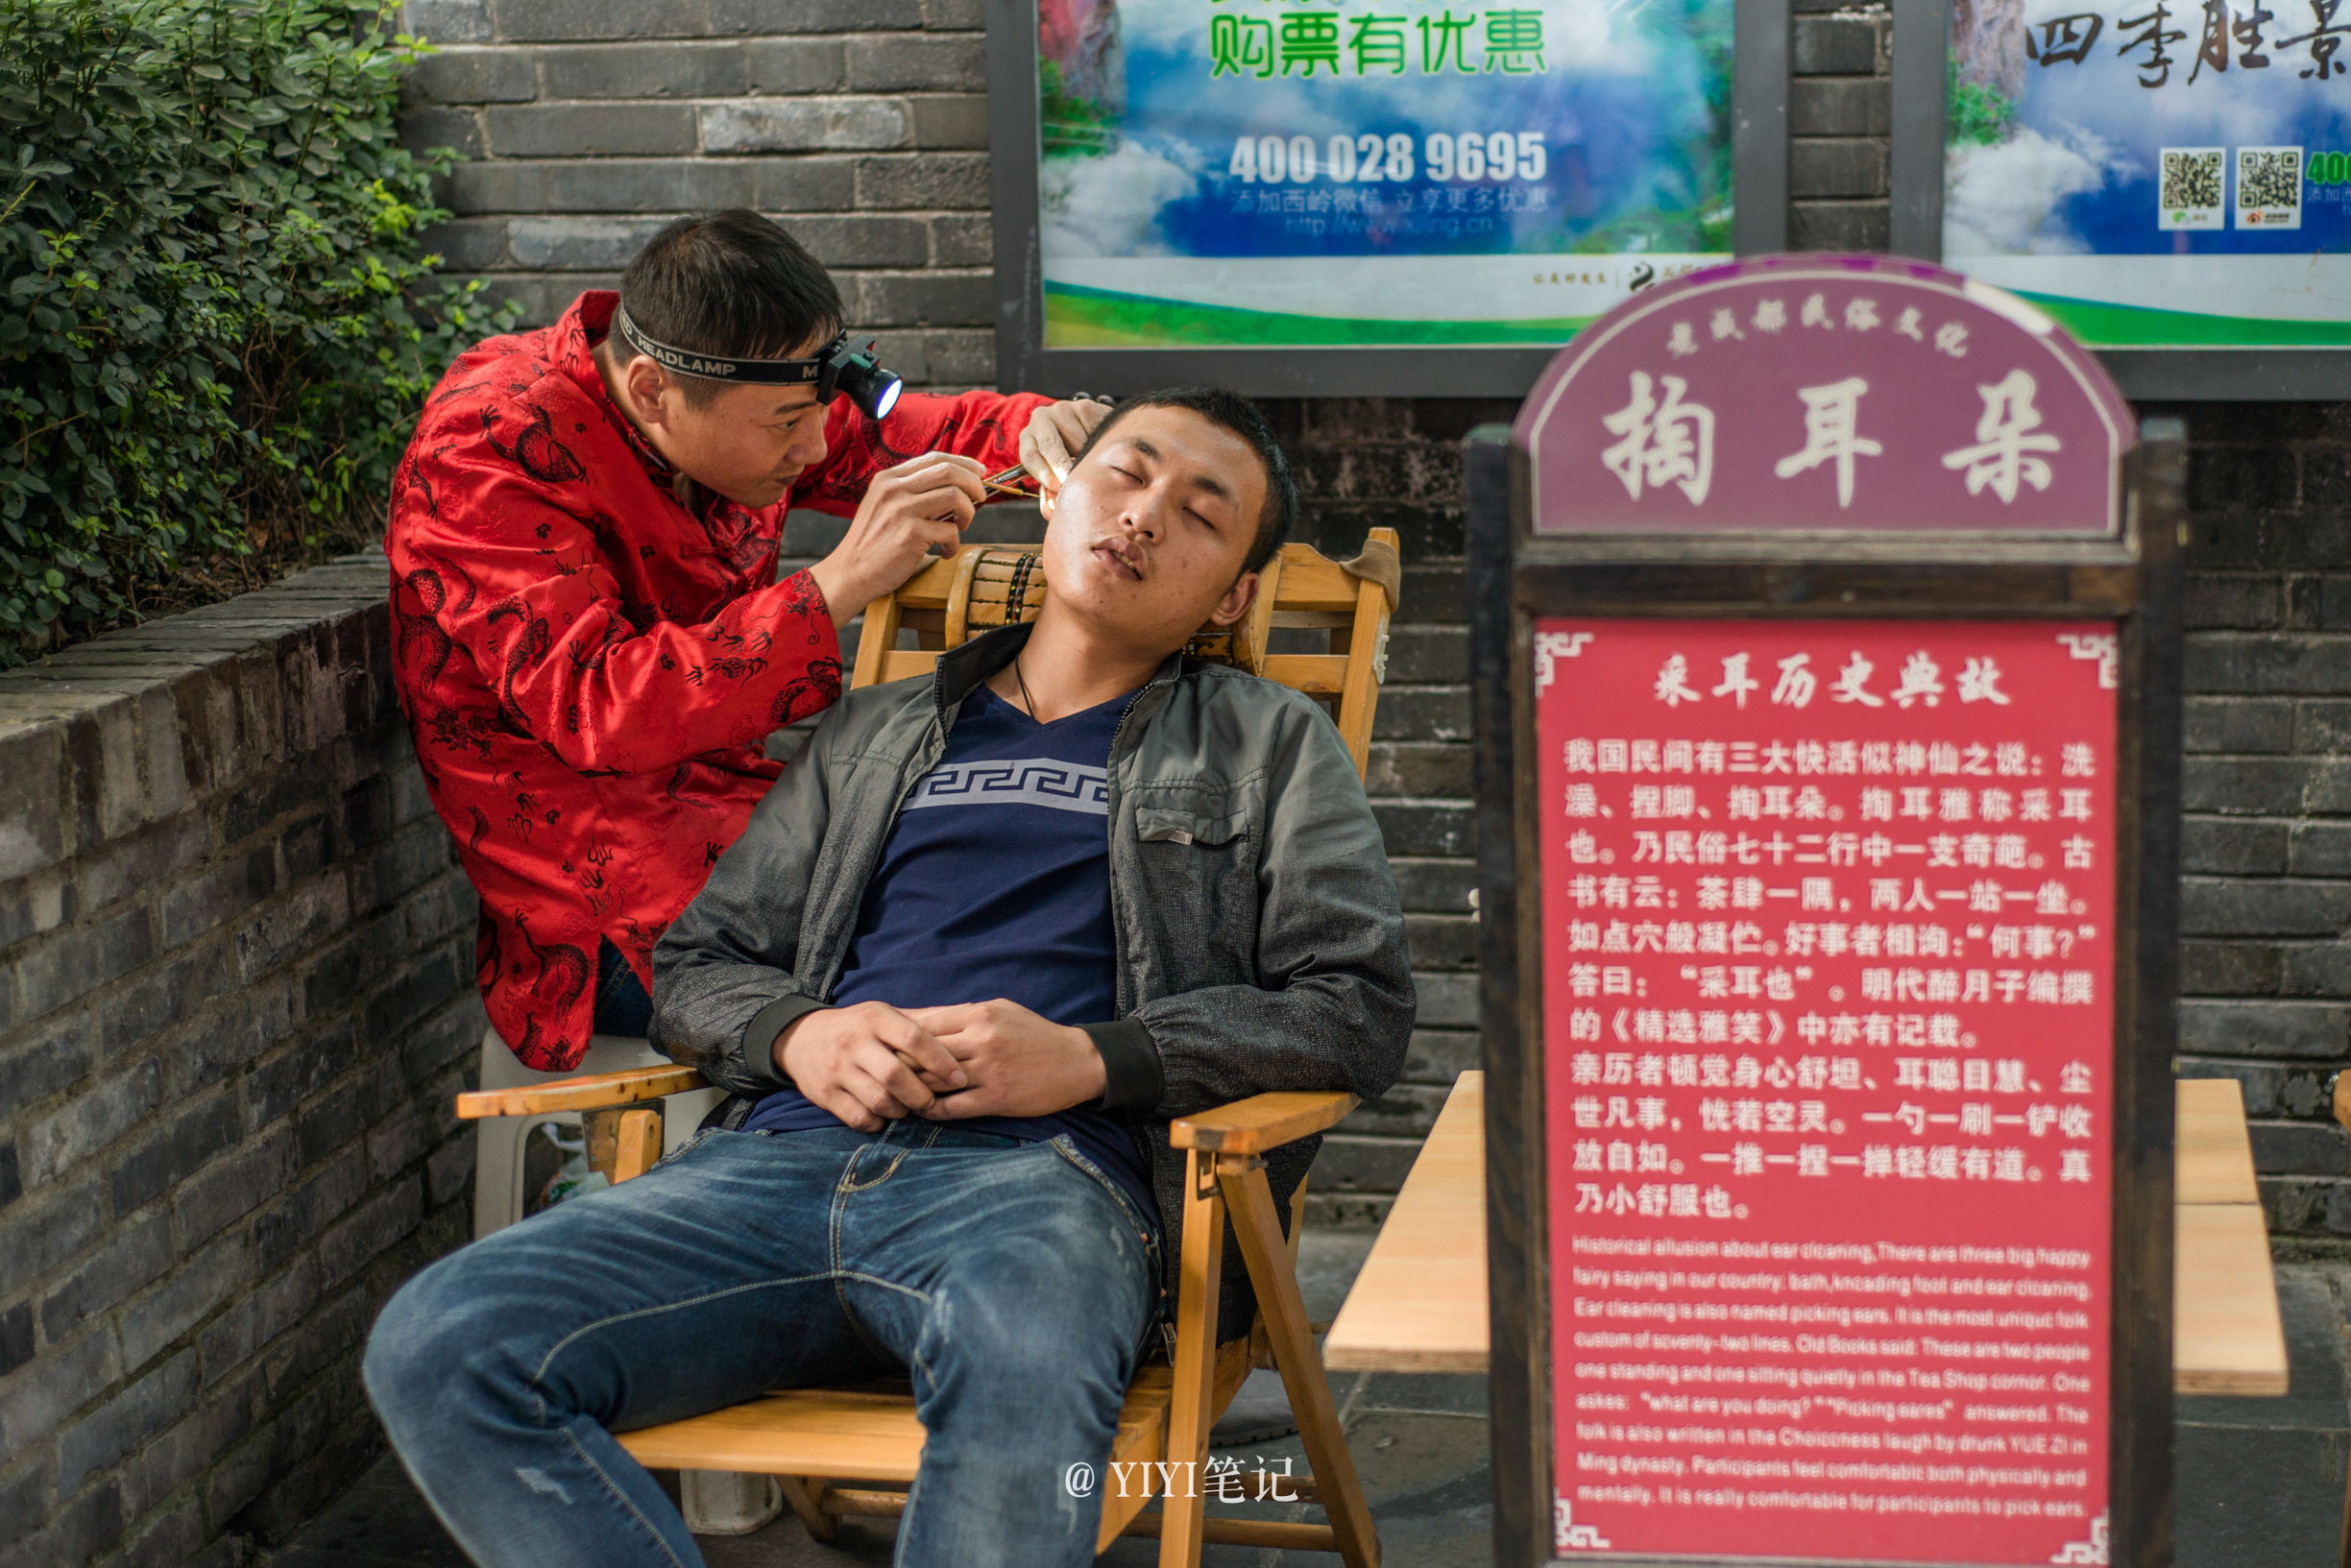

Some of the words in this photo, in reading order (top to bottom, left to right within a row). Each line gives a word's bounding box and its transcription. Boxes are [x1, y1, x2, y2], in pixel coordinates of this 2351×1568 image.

[1209, 10, 1548, 79] 购票有优惠
[2026, 0, 2351, 87] 四季胜景
[1229, 135, 1316, 184] 400
[1335, 133, 1415, 182] 028
[1425, 132, 1547, 181] 9695
[638, 335, 737, 375] HEADLAMP
[1601, 370, 2060, 508] 掏耳朵
[1654, 650, 2011, 709] 采耳历史典故
[1574, 1181, 1749, 1220] 乃小舒服也。
[1572, 1236, 1651, 1255] Historical
[1653, 1239, 1718, 1256] allusion
[1720, 1241, 1768, 1258] about
[1770, 1242, 1798, 1259] ear
[1927, 1245, 1957, 1263] are
[1959, 1245, 2004, 1264] three
[2007, 1246, 2034, 1267] big
[2036, 1247, 2090, 1268] happy
[1573, 1266, 1610, 1288] fairy
[1612, 1270, 1667, 1291] saying
[1669, 1271, 1685, 1287] in
[1687, 1271, 1716, 1289] our
[1913, 1274, 1948, 1293] foot
[1951, 1277, 1982, 1294] and
[1984, 1279, 2013, 1295] ear
[1573, 1296, 1604, 1316] Ear
[1678, 1303, 1692, 1318] is
[1693, 1303, 1728, 1319] also
[1730, 1304, 1787, 1321] named
[1789, 1305, 1850, 1327] picking
[1852, 1307, 1892, 1323] ears.
[1895, 1307, 1906, 1323] It
[1908, 1309, 1923, 1324] is
[1925, 1308, 1951, 1325] the
[1952, 1309, 1994, 1326] most
[2055, 1310, 2089, 1329] folk
[1574, 1331, 1632, 1348] custom
[1633, 1330, 1651, 1349] of
[1751, 1335, 1794, 1352] lines.
[1796, 1333, 1825, 1354] Old
[1827, 1334, 1877, 1355] Books
[1973, 1341, 2000, 1358] are
[2002, 1341, 2032, 1359] two
[2033, 1342, 2090, 1363] people
[1574, 1363, 1607, 1378] one
[1609, 1363, 1678, 1385] standing
[1681, 1364, 1711, 1382] and
[1713, 1366, 1745, 1383] one
[1747, 1366, 1798, 1387] sitting
[1800, 1368, 1856, 1387] quietly
[1858, 1369, 1875, 1386] in
[1877, 1369, 1904, 1387] the
[1908, 1367, 1940, 1387] Tea
[1942, 1368, 1987, 1391] Shop
[2052, 1370, 2090, 1392] One
[1690, 1396, 1718, 1412] are
[1721, 1397, 1752, 1416] you
[1964, 1405, 2051, 1421] answered.
[2055, 1402, 2089, 1424] The
[1576, 1422, 1607, 1439] folk
[1610, 1425, 1624, 1440] is
[1626, 1425, 1663, 1442] also
[1666, 1427, 1725, 1443] written
[1728, 1428, 1745, 1443] in
[1747, 1428, 1776, 1445] the
[1882, 1433, 1931, 1454] laugh
[1934, 1434, 1955, 1454] by
[1958, 1435, 2006, 1452] drunk
[2010, 1434, 2047, 1454] YUE
[2048, 1434, 2068, 1454] ZI
[2072, 1437, 2087, 1455] in
[1577, 1451, 1617, 1475] Ming
[1619, 1455, 1689, 1476] dynasty.
[1691, 1455, 1790, 1477] Participants
[1792, 1459, 1824, 1478] feel
[1827, 1462, 1924, 1481] comfortable
[1927, 1464, 1964, 1482] both
[1967, 1466, 2050, 1487] physically
[2053, 1468, 2087, 1488] and
[1578, 1485, 1655, 1506] mentally.
[1659, 1485, 1672, 1504] It
[1675, 1488, 1691, 1505] is
[1695, 1489, 1744, 1508] really
[1747, 1491, 1847, 1509] comfortable
[1850, 1492, 1875, 1510] for
[1877, 1495, 1980, 1513] participants
[1983, 1497, 2001, 1514] to
[2004, 1499, 2041, 1516] pick
[2043, 1500, 2089, 1517] ears.
